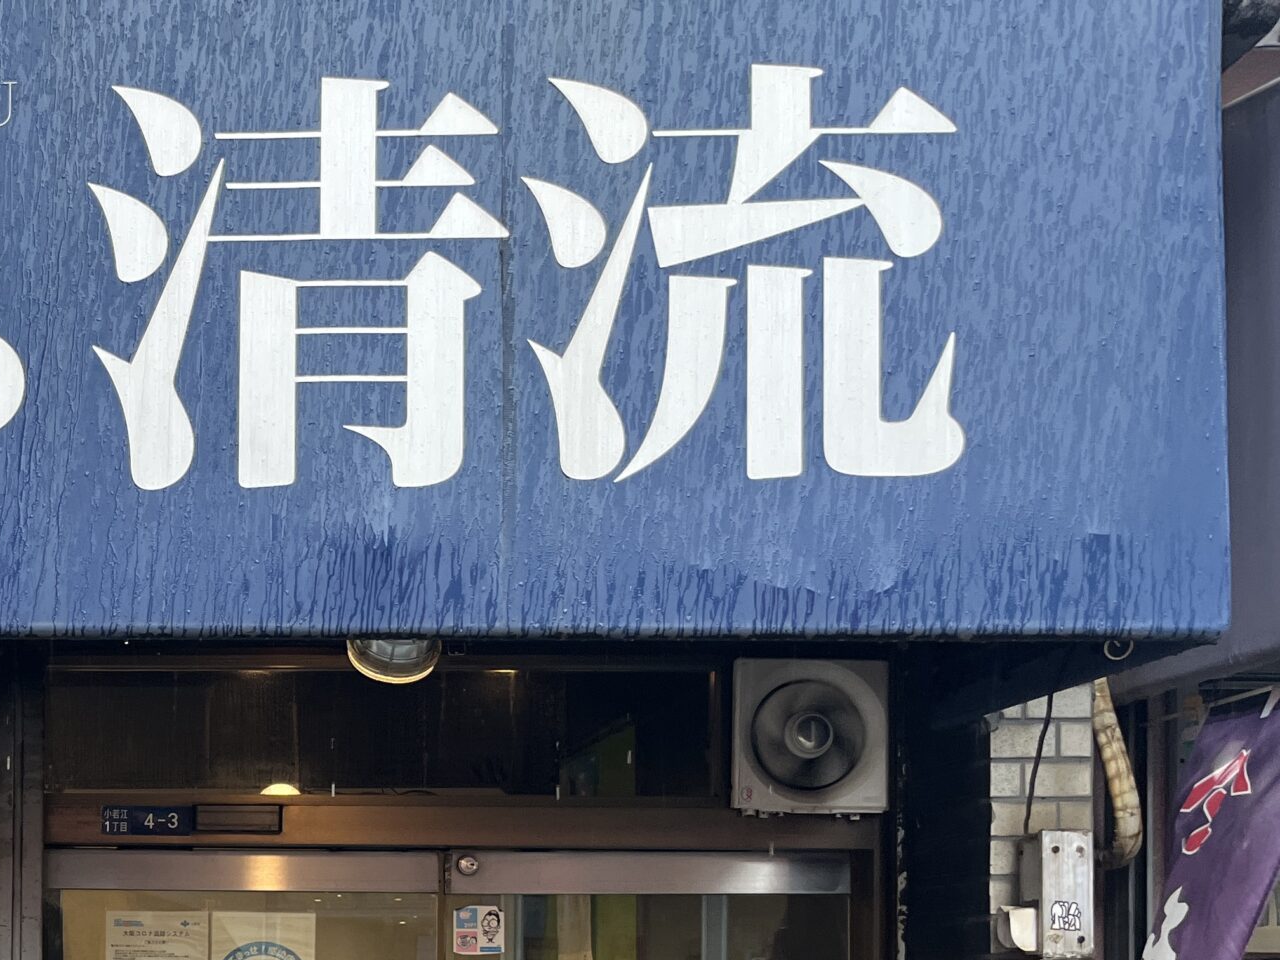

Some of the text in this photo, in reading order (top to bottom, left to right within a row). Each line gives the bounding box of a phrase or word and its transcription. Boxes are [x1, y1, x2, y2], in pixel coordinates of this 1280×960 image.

[88, 64, 966, 489] 清流
[103, 809, 128, 819] 小若江
[143, 812, 179, 829] 4-3
[104, 820, 128, 832] 1丁目
